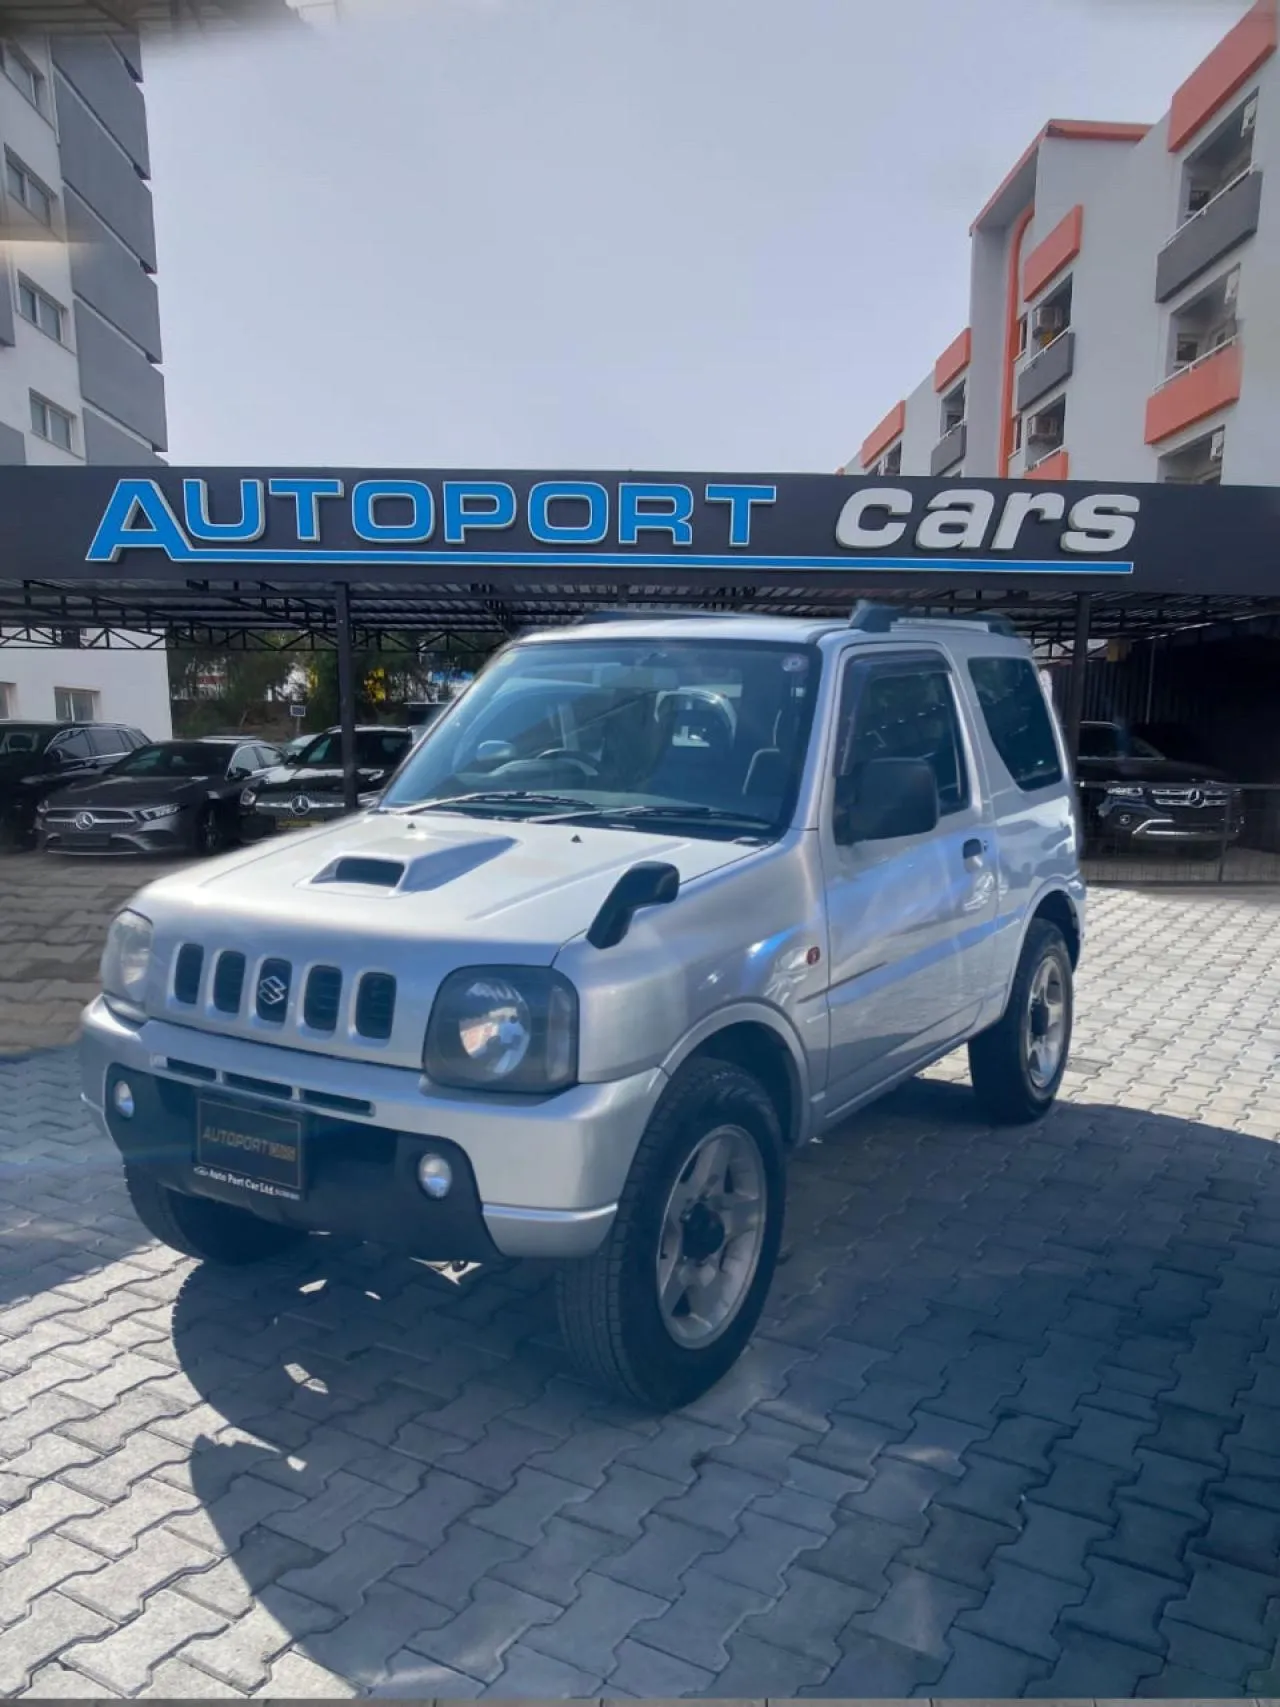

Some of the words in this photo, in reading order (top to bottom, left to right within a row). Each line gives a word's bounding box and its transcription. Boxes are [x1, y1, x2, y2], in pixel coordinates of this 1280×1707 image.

[85, 478, 777, 563] AUTOPORT
[835, 487, 1140, 553] cars
[202, 1125, 269, 1155] AUTOPORT
[209, 1168, 227, 1182] Auto
[245, 1178, 259, 1191] Car
